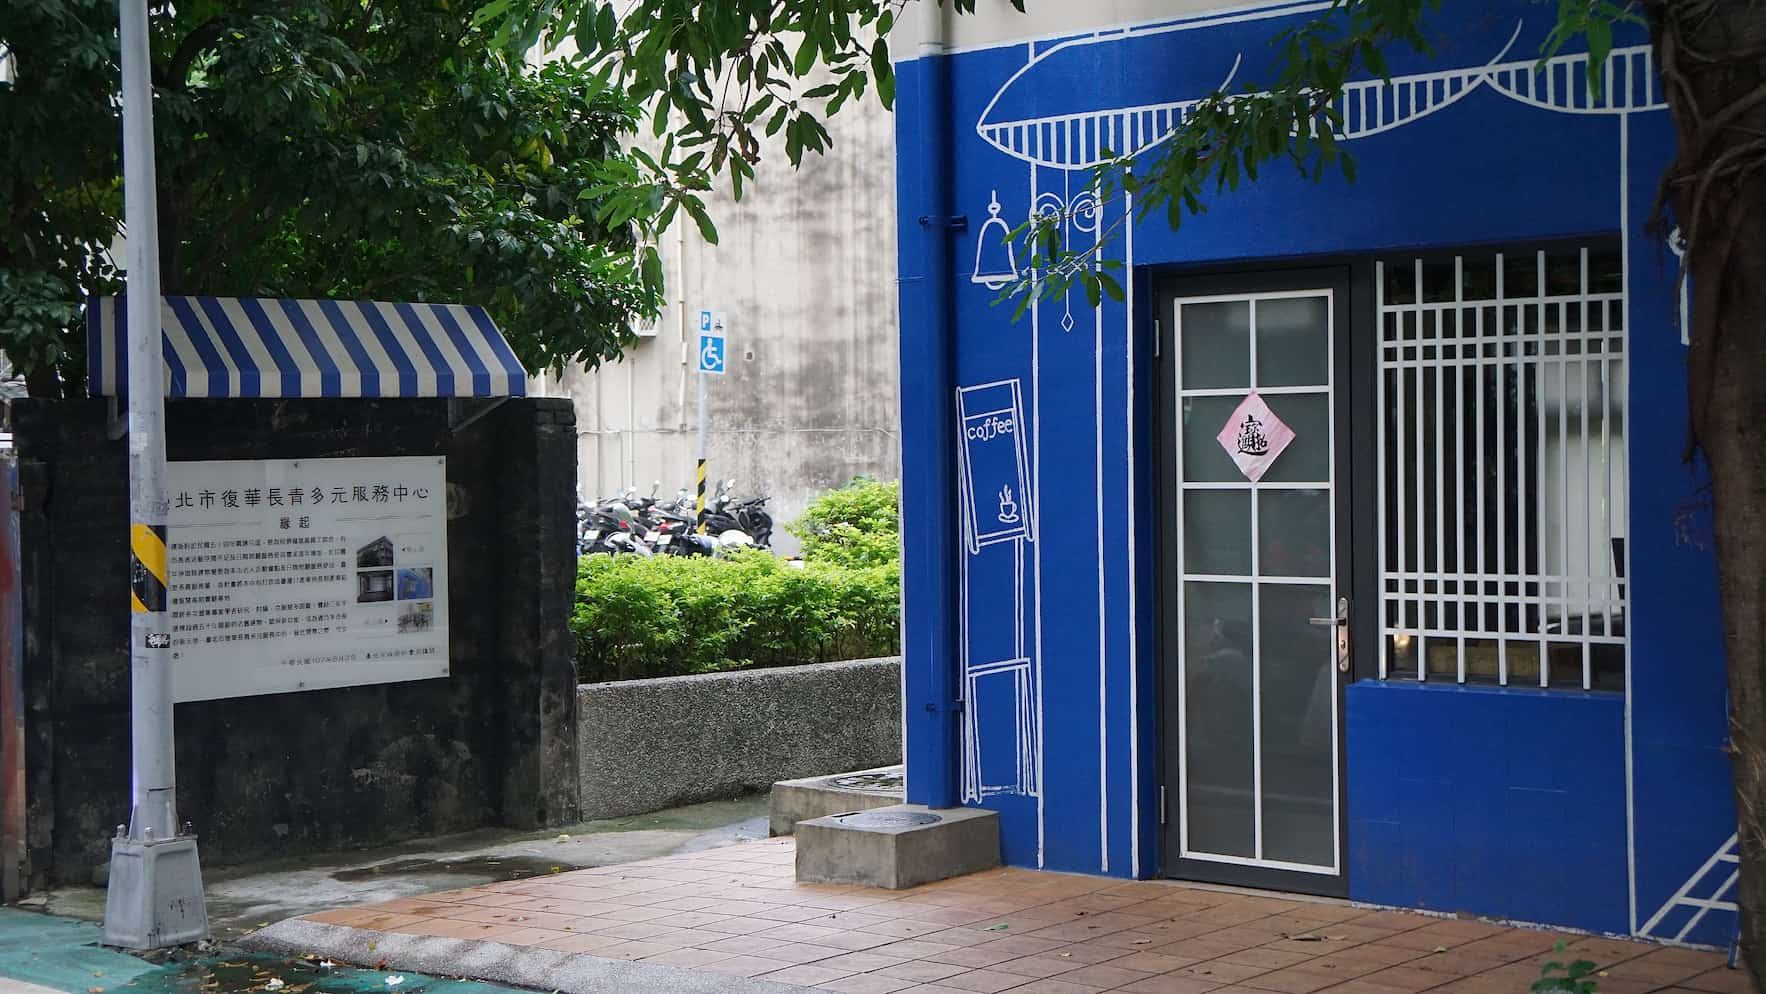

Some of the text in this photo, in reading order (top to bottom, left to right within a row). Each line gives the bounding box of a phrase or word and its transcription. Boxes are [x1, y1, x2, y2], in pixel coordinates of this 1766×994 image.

[967, 417, 1013, 441] coffee
[167, 483, 429, 509] 北市復華長青多元服務中心
